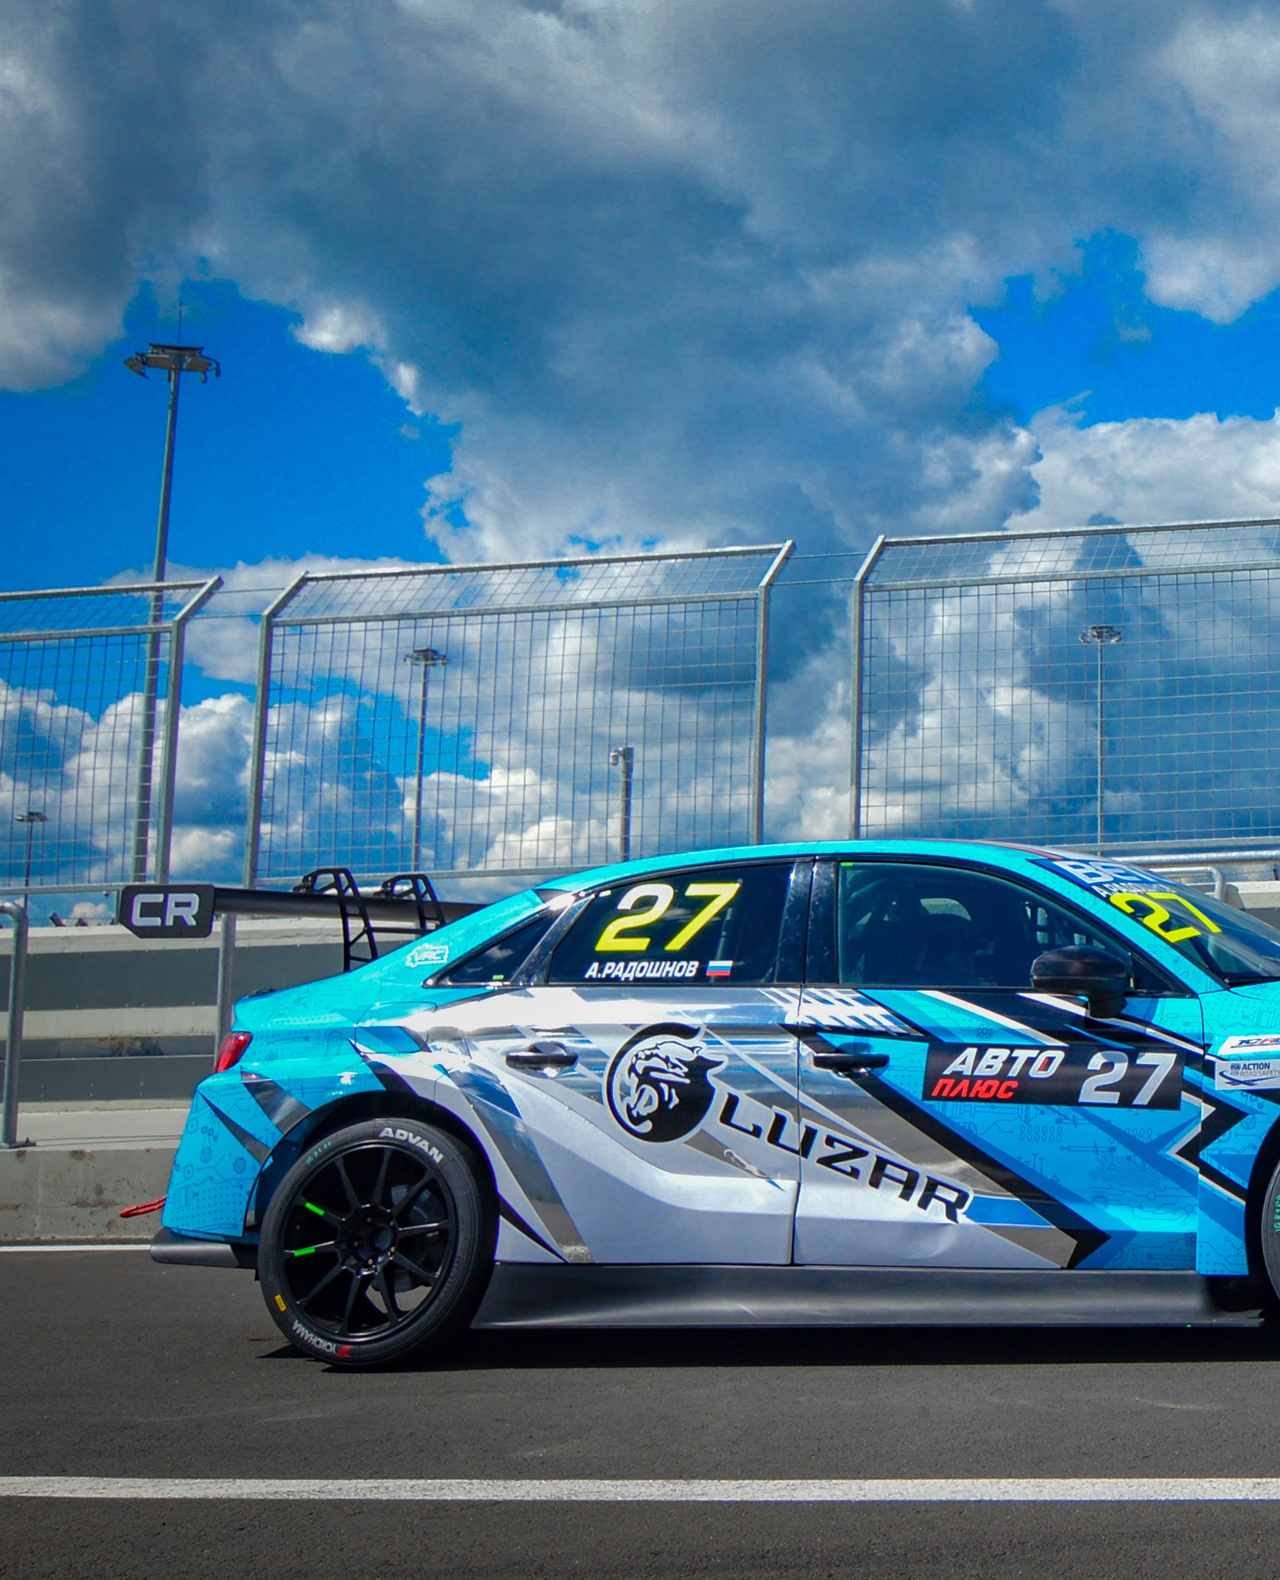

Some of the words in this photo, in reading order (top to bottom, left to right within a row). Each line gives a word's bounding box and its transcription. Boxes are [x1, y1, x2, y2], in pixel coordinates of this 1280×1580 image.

[132, 893, 199, 926] CR
[594, 883, 741, 951] 27
[1109, 891, 1222, 943] 27
[584, 960, 700, 981] А.РАДОШНОВ
[942, 1047, 1065, 1078] АВТО
[1078, 1051, 1178, 1106] 27
[1242, 1062, 1271, 1071] ACTION
[1258, 1069, 1280, 1077] SAFETY
[931, 1078, 1019, 1099] ПЛЮС
[378, 1127, 444, 1164] ADVAN
[719, 1092, 972, 1224] LUZAR
[292, 1320, 337, 1354] YOKOHAMA
